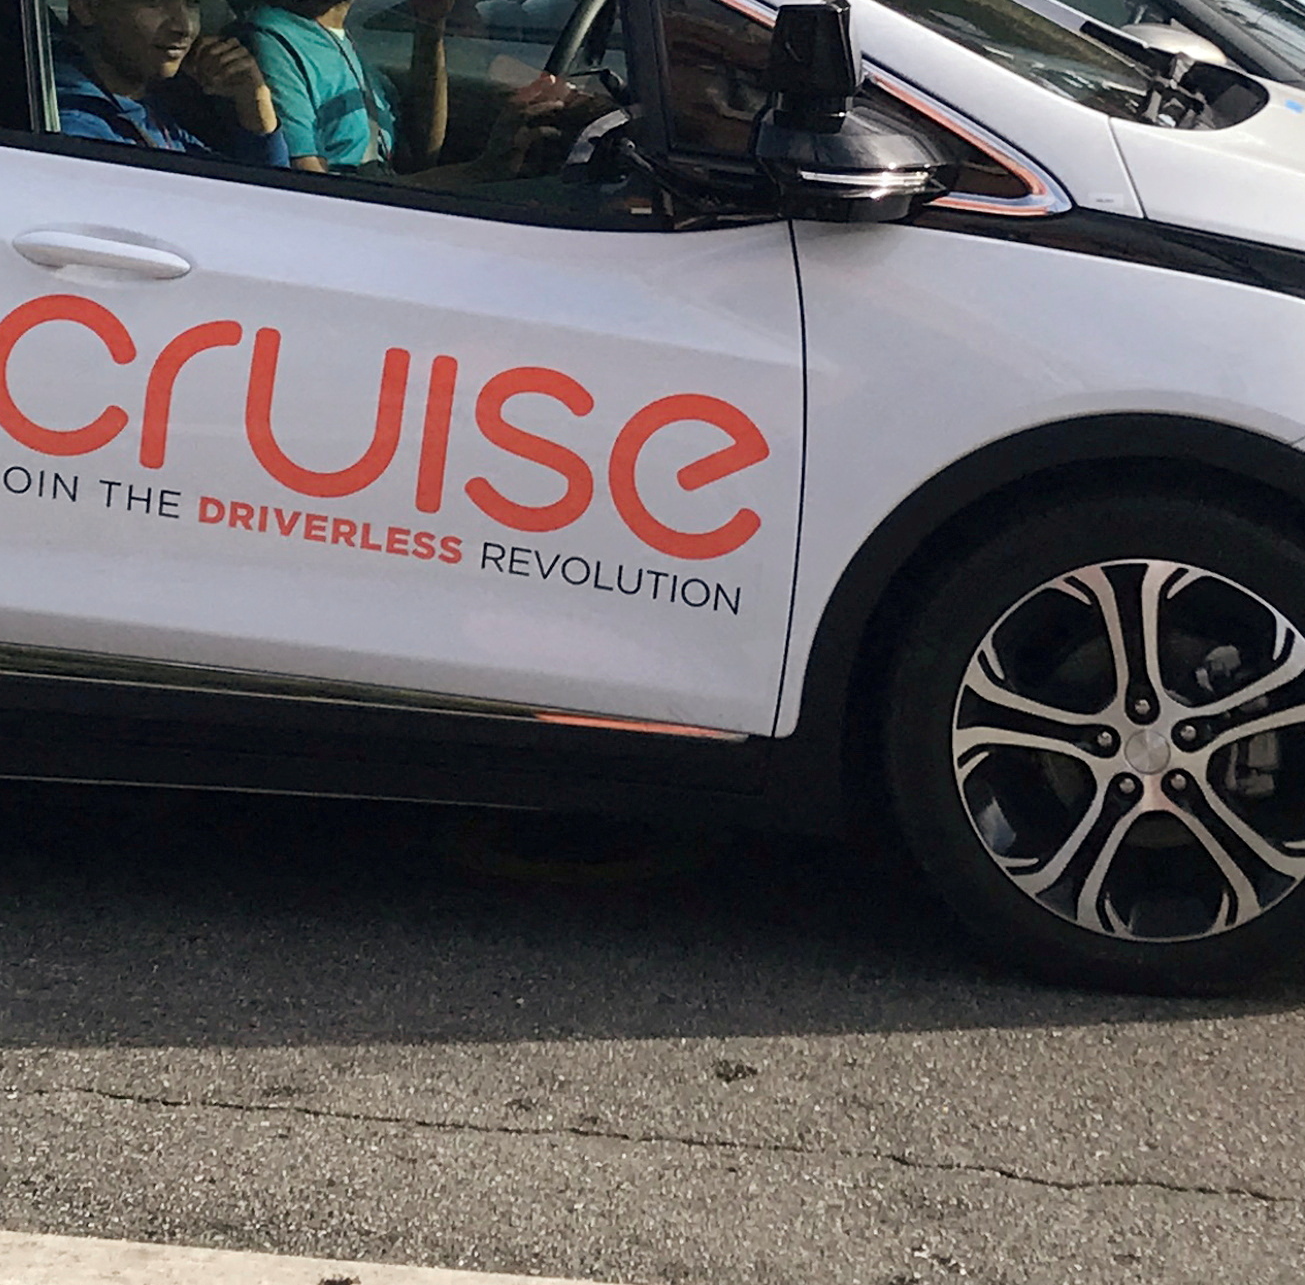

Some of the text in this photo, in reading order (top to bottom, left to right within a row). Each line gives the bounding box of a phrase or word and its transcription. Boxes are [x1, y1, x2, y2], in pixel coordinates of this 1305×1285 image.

[99, 479, 181, 519] THE
[197, 496, 463, 564] DRIVERLESS
[481, 541, 741, 616] REVOLUTION
